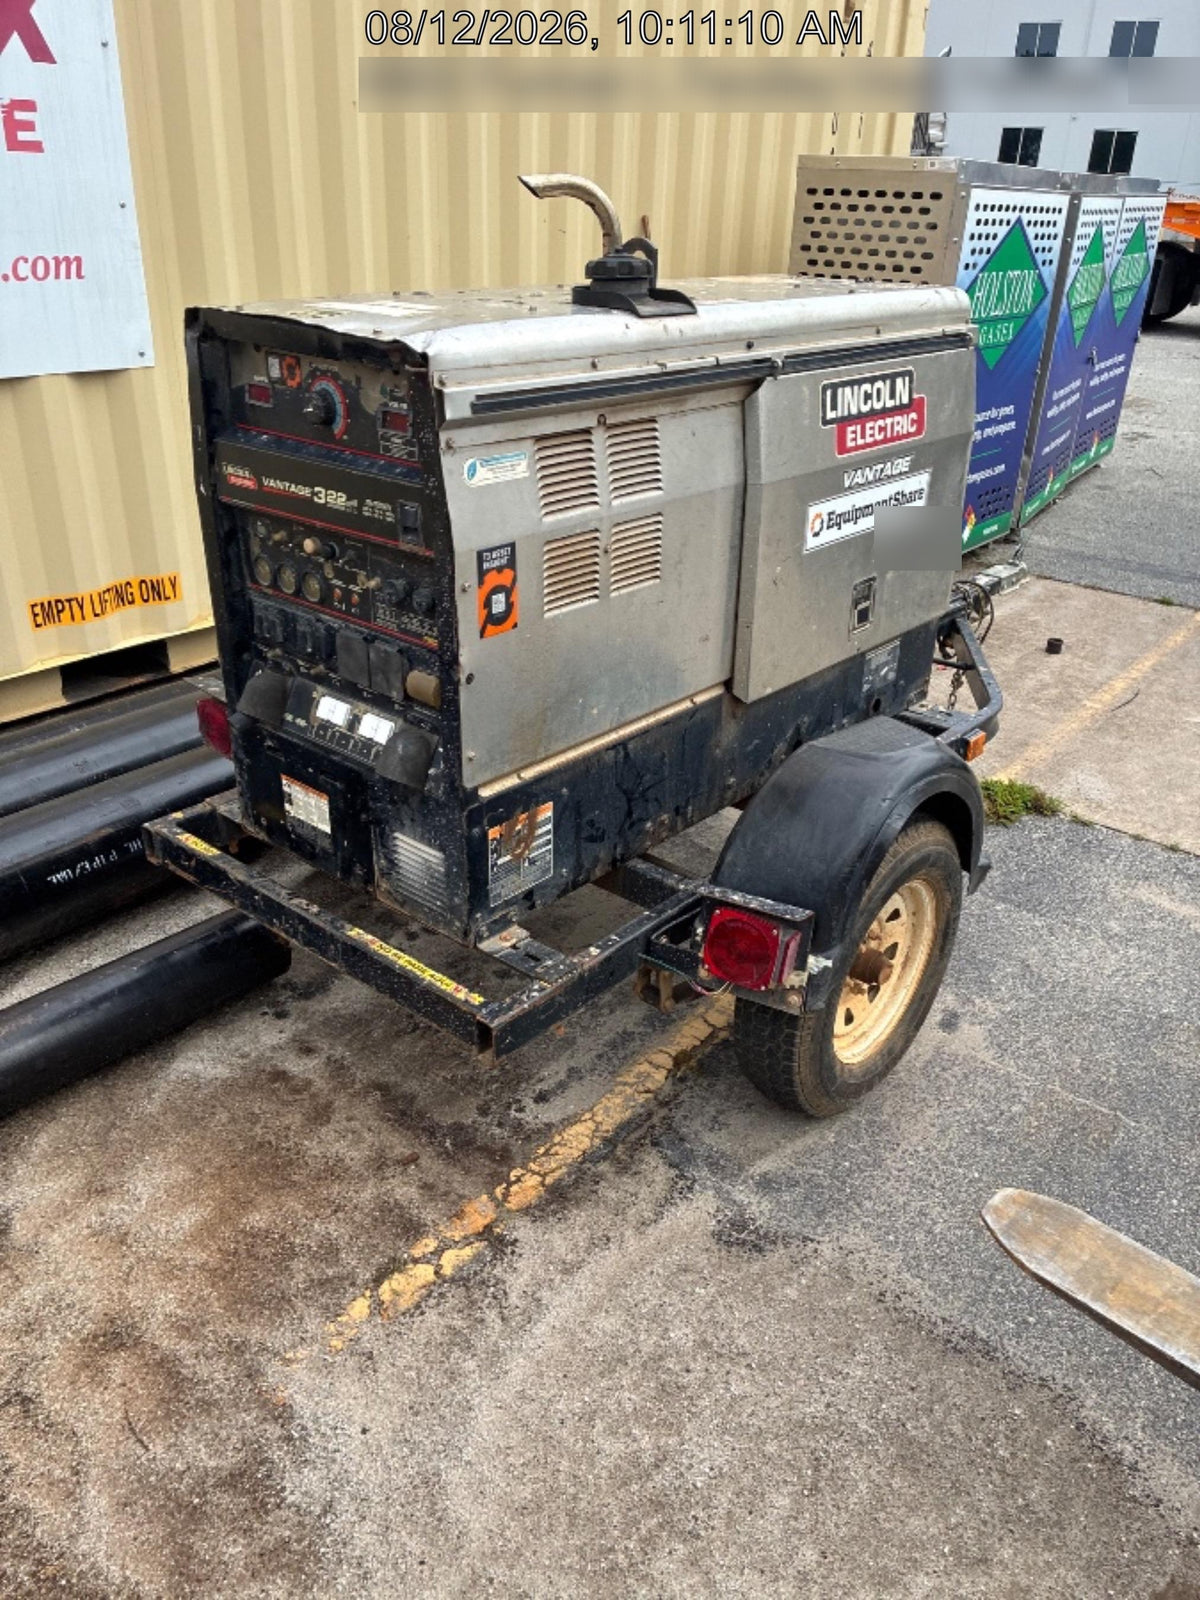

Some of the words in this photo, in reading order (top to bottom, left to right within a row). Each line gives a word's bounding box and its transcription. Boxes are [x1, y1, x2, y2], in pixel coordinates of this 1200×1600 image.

[970, 270, 1039, 318] HOLSTON
[825, 376, 910, 420] LINCOLN
[846, 412, 918, 448] ELECTRIC
[261, 476, 313, 497] VANTAGE
[313, 486, 348, 506] 322
[843, 454, 913, 488] VANTAGE
[30, 596, 86, 628] EMPTY
[90, 581, 136, 617] LIFTING
[139, 575, 178, 602] ONLY
